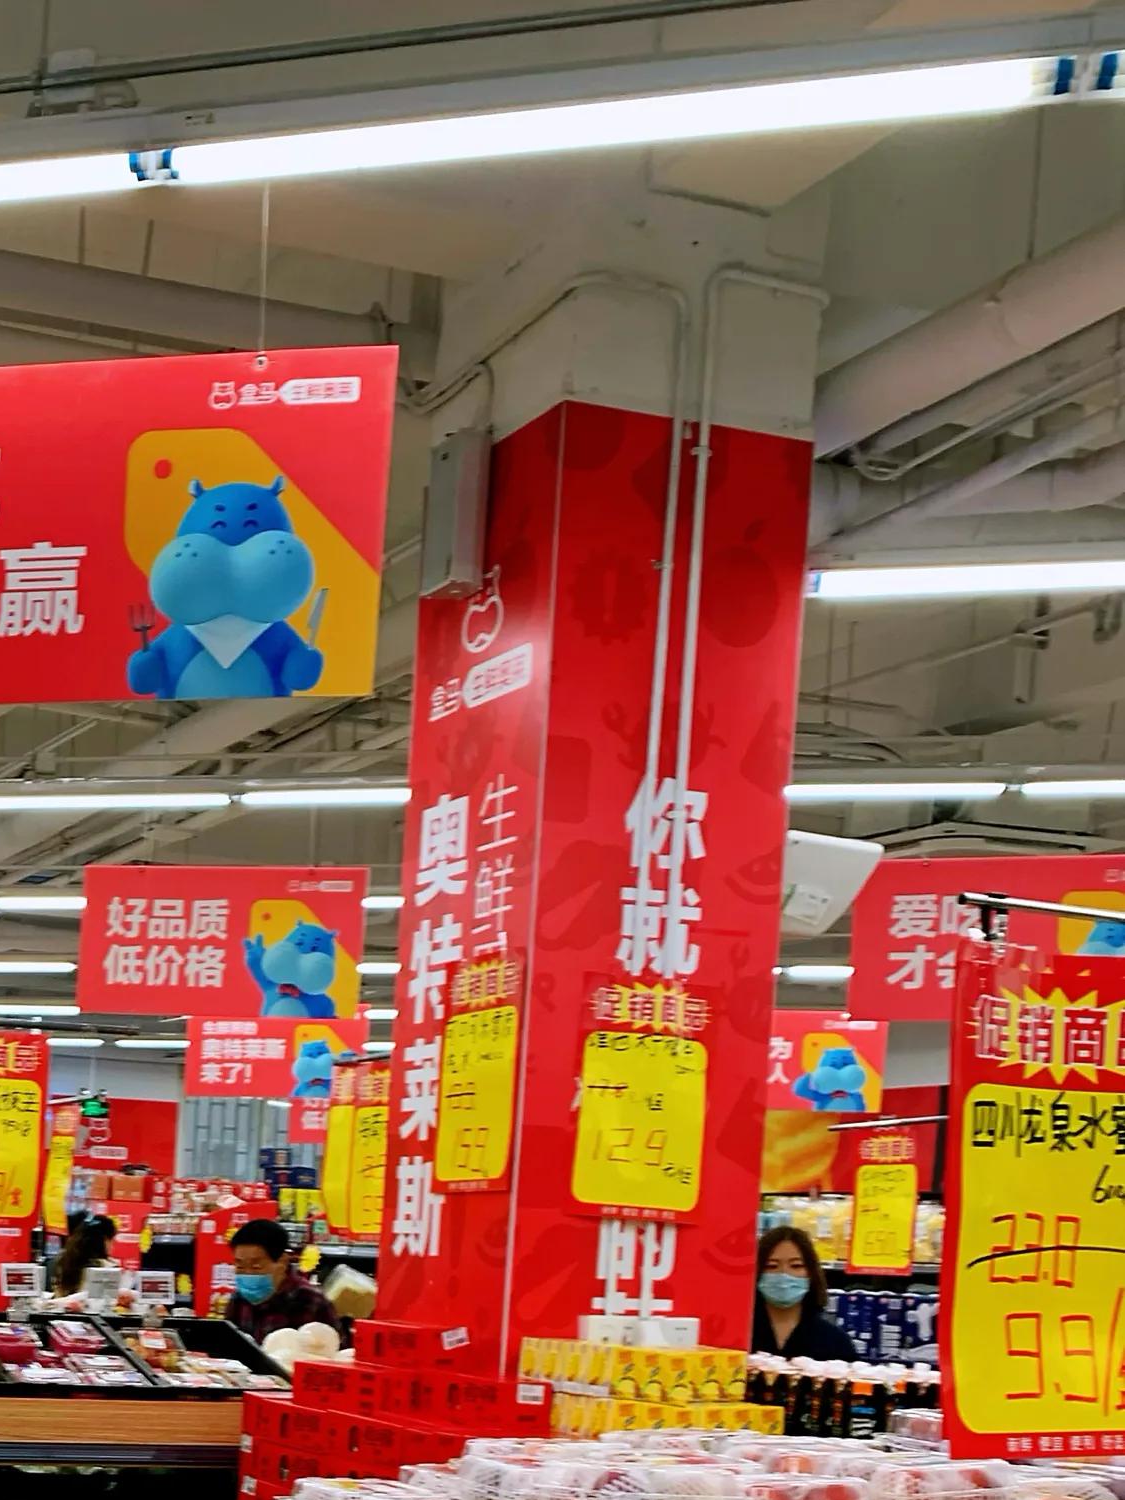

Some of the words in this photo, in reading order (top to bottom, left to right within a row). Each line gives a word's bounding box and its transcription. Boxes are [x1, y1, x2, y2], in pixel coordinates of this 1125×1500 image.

[106, 896, 230, 940] 好品质
[103, 945, 227, 988] 低价格
[973, 994, 1125, 1069] 促销商
